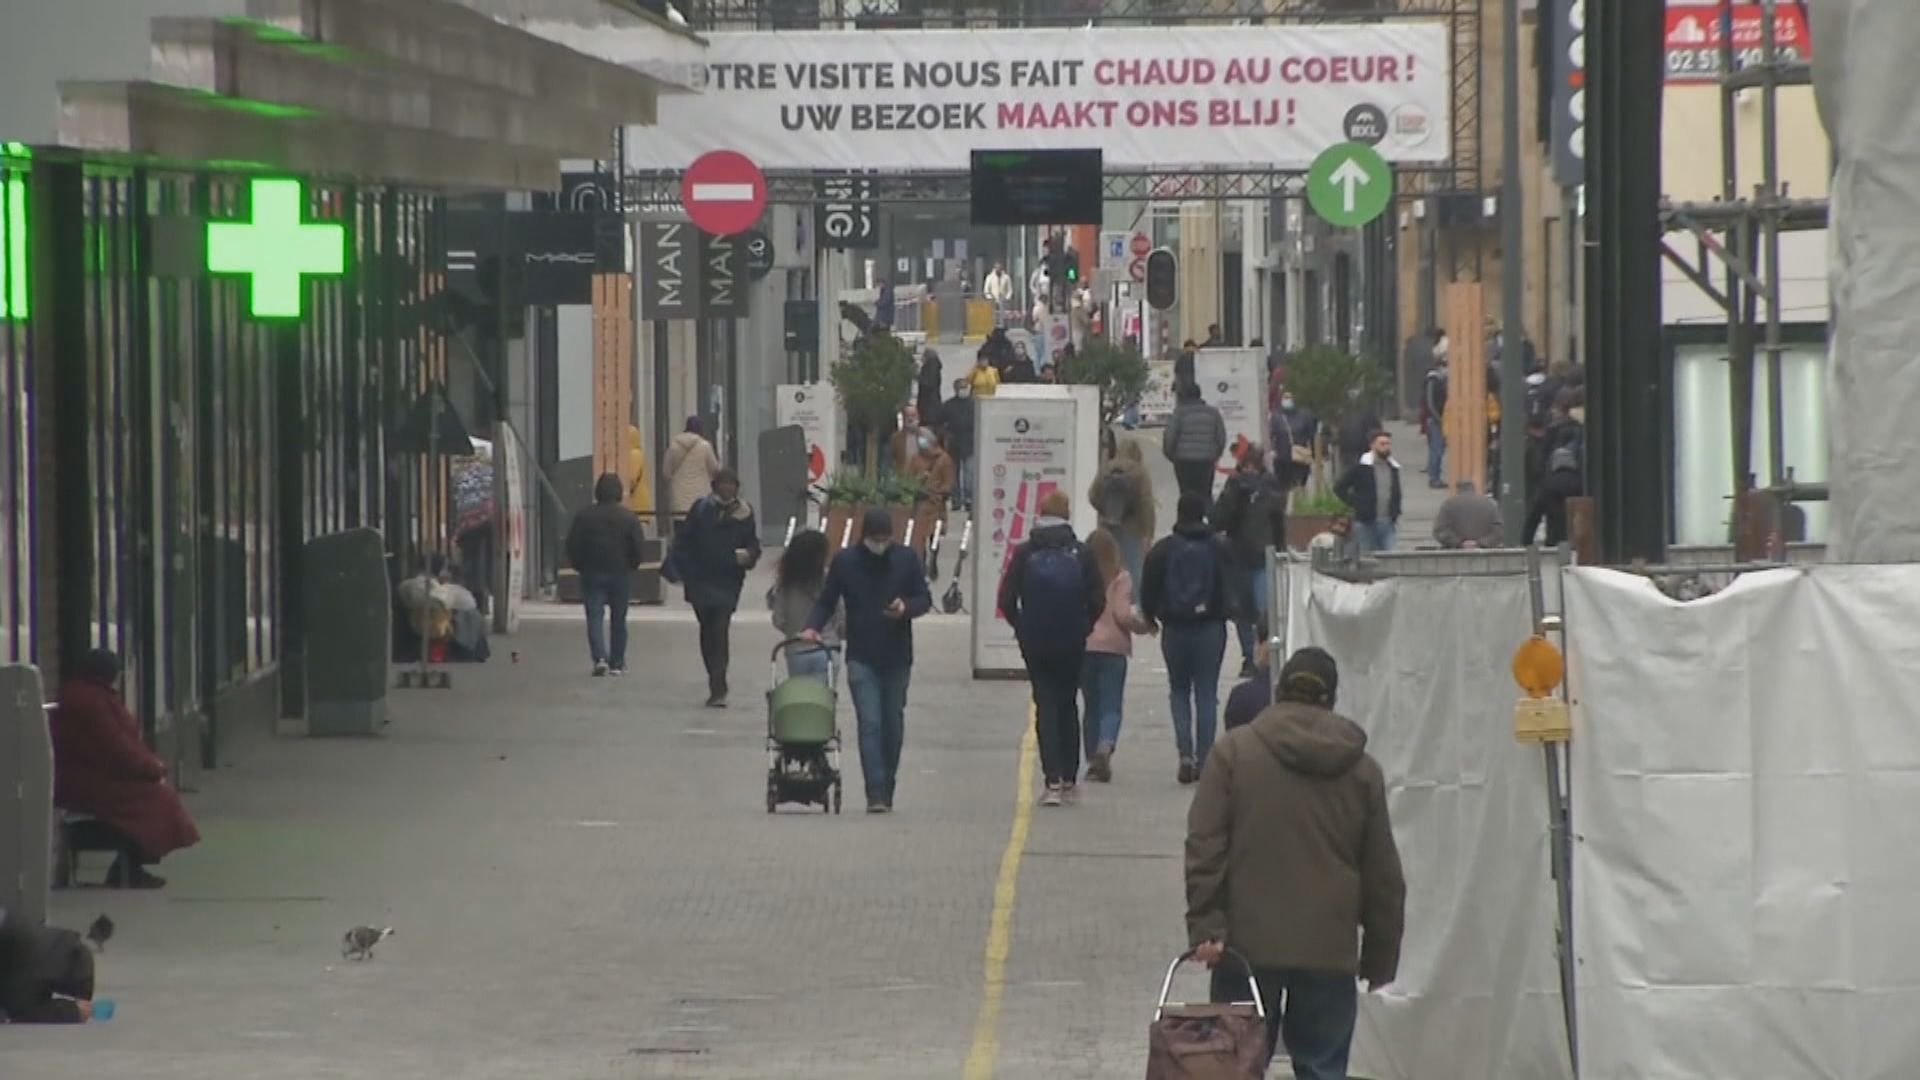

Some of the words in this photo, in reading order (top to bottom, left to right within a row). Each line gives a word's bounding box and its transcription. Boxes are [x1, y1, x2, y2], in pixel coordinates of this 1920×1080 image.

[1669, 49, 1694, 71] 02
[784, 63, 894, 89] VISITE
[903, 61, 1001, 89] NOUS
[1010, 60, 1083, 88] FAIT
[1094, 59, 1215, 86] CHAUD
[1223, 58, 1270, 85] AU
[780, 104, 842, 131] UW
[851, 103, 986, 131] BEZOEK
[997, 102, 1118, 129] MAAKT
[1126, 100, 1198, 127] ONS
[1351, 126, 1381, 139] BXL
